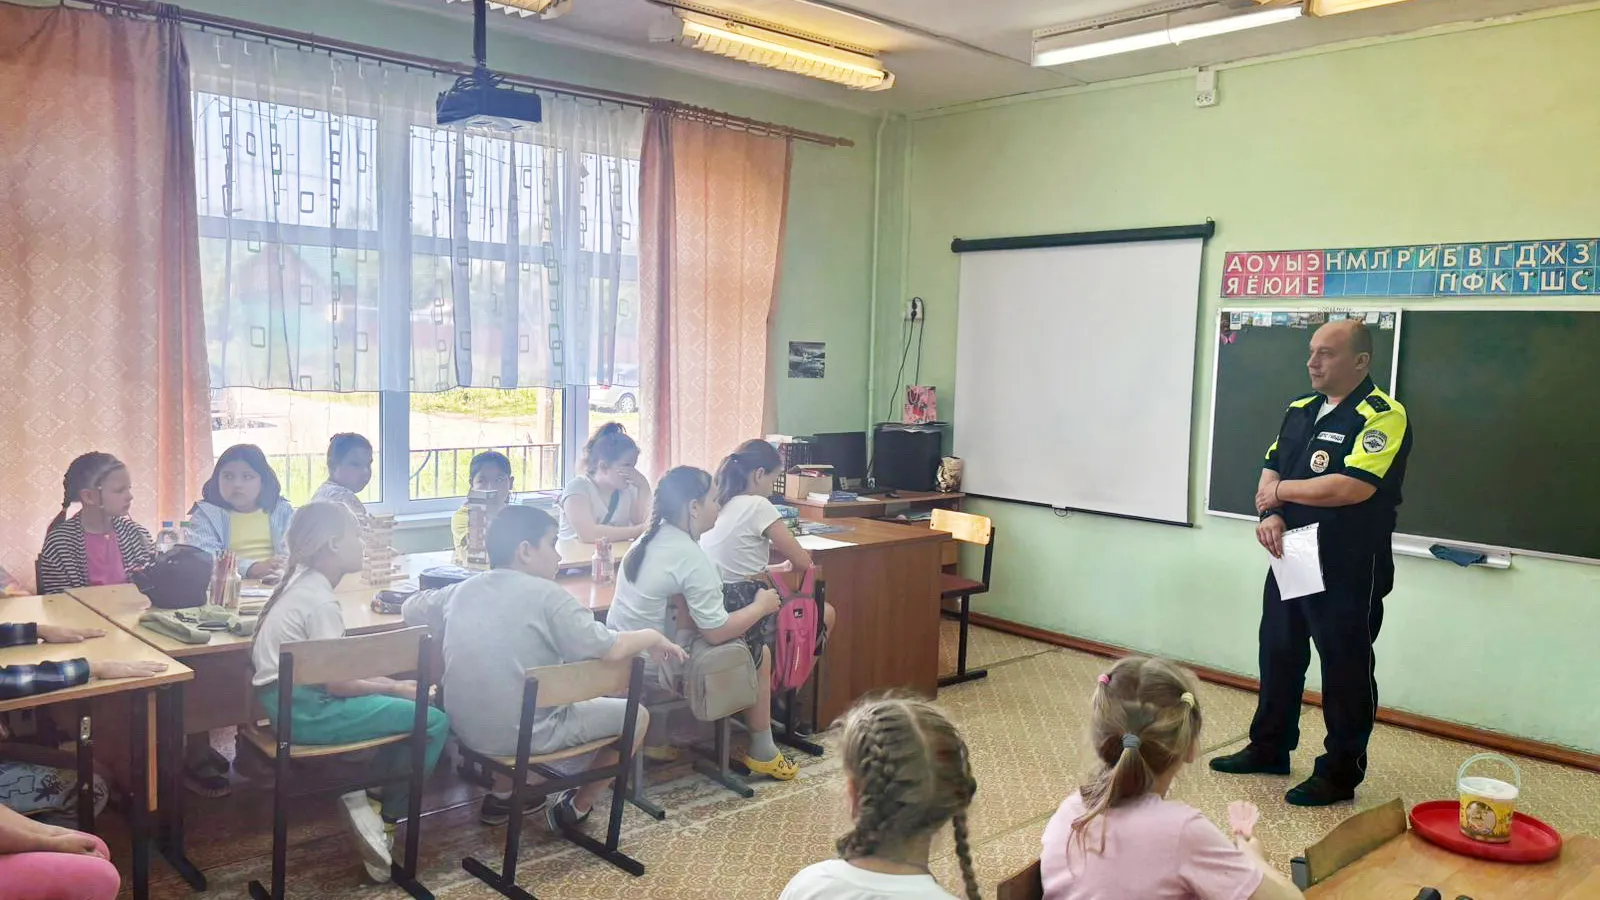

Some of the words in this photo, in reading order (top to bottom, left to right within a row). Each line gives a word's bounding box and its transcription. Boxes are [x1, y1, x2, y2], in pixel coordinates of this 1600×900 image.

[1227, 255, 1242, 272] А
[1246, 255, 1263, 272] О
[1267, 255, 1280, 272] У
[1286, 254, 1302, 271] Ы
[1306, 253, 1320, 271] Э
[1326, 252, 1341, 270] Н
[1347, 252, 1367, 269] М
[1370, 251, 1387, 269] Л
[1397, 249, 1411, 268] Р
[1443, 248, 1457, 267] Б
[1468, 247, 1483, 267] В
[1494, 246, 1509, 266] Г
[1516, 245, 1537, 268] Д
[1541, 244, 1565, 264] Ж
[1572, 243, 1590, 264] З
[1226, 277, 1239, 294] Я
[1246, 274, 1259, 295] Ё
[1263, 277, 1282, 295] Ю
[1284, 277, 1300, 295] И
[1307, 277, 1319, 295] Е
[1439, 273, 1457, 291] П
[1462, 273, 1484, 291] Ф
[1490, 272, 1508, 291] К
[1519, 271, 1535, 291] Т
[1540, 271, 1564, 291] Ш
[1571, 270, 1589, 291] С
